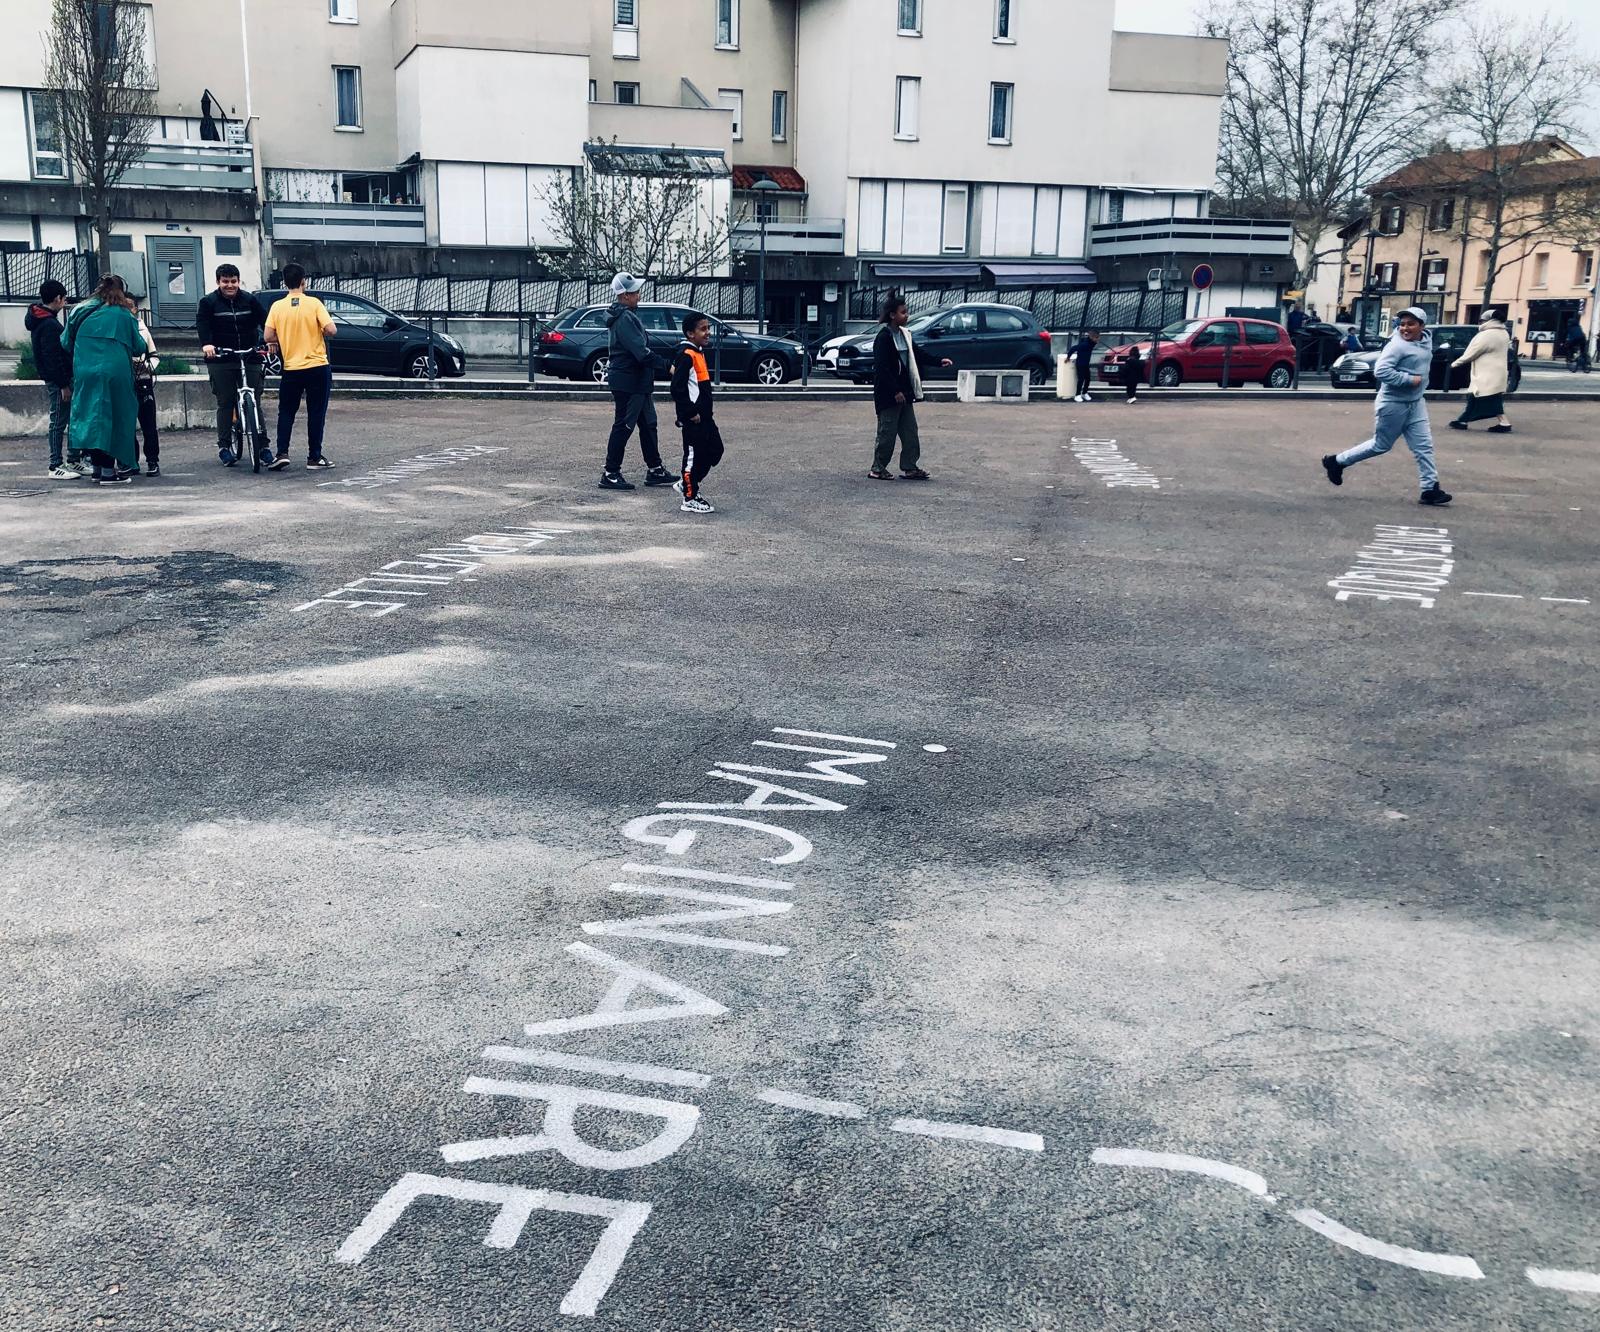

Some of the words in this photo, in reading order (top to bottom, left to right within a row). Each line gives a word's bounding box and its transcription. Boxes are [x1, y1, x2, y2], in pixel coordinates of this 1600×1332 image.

[315, 444, 509, 489] PERSONNAGE
[289, 526, 573, 617] MERVEILLE
[1326, 524, 1455, 608] FANTASTIQUE
[335, 726, 897, 1317] IMAGINAIRE
